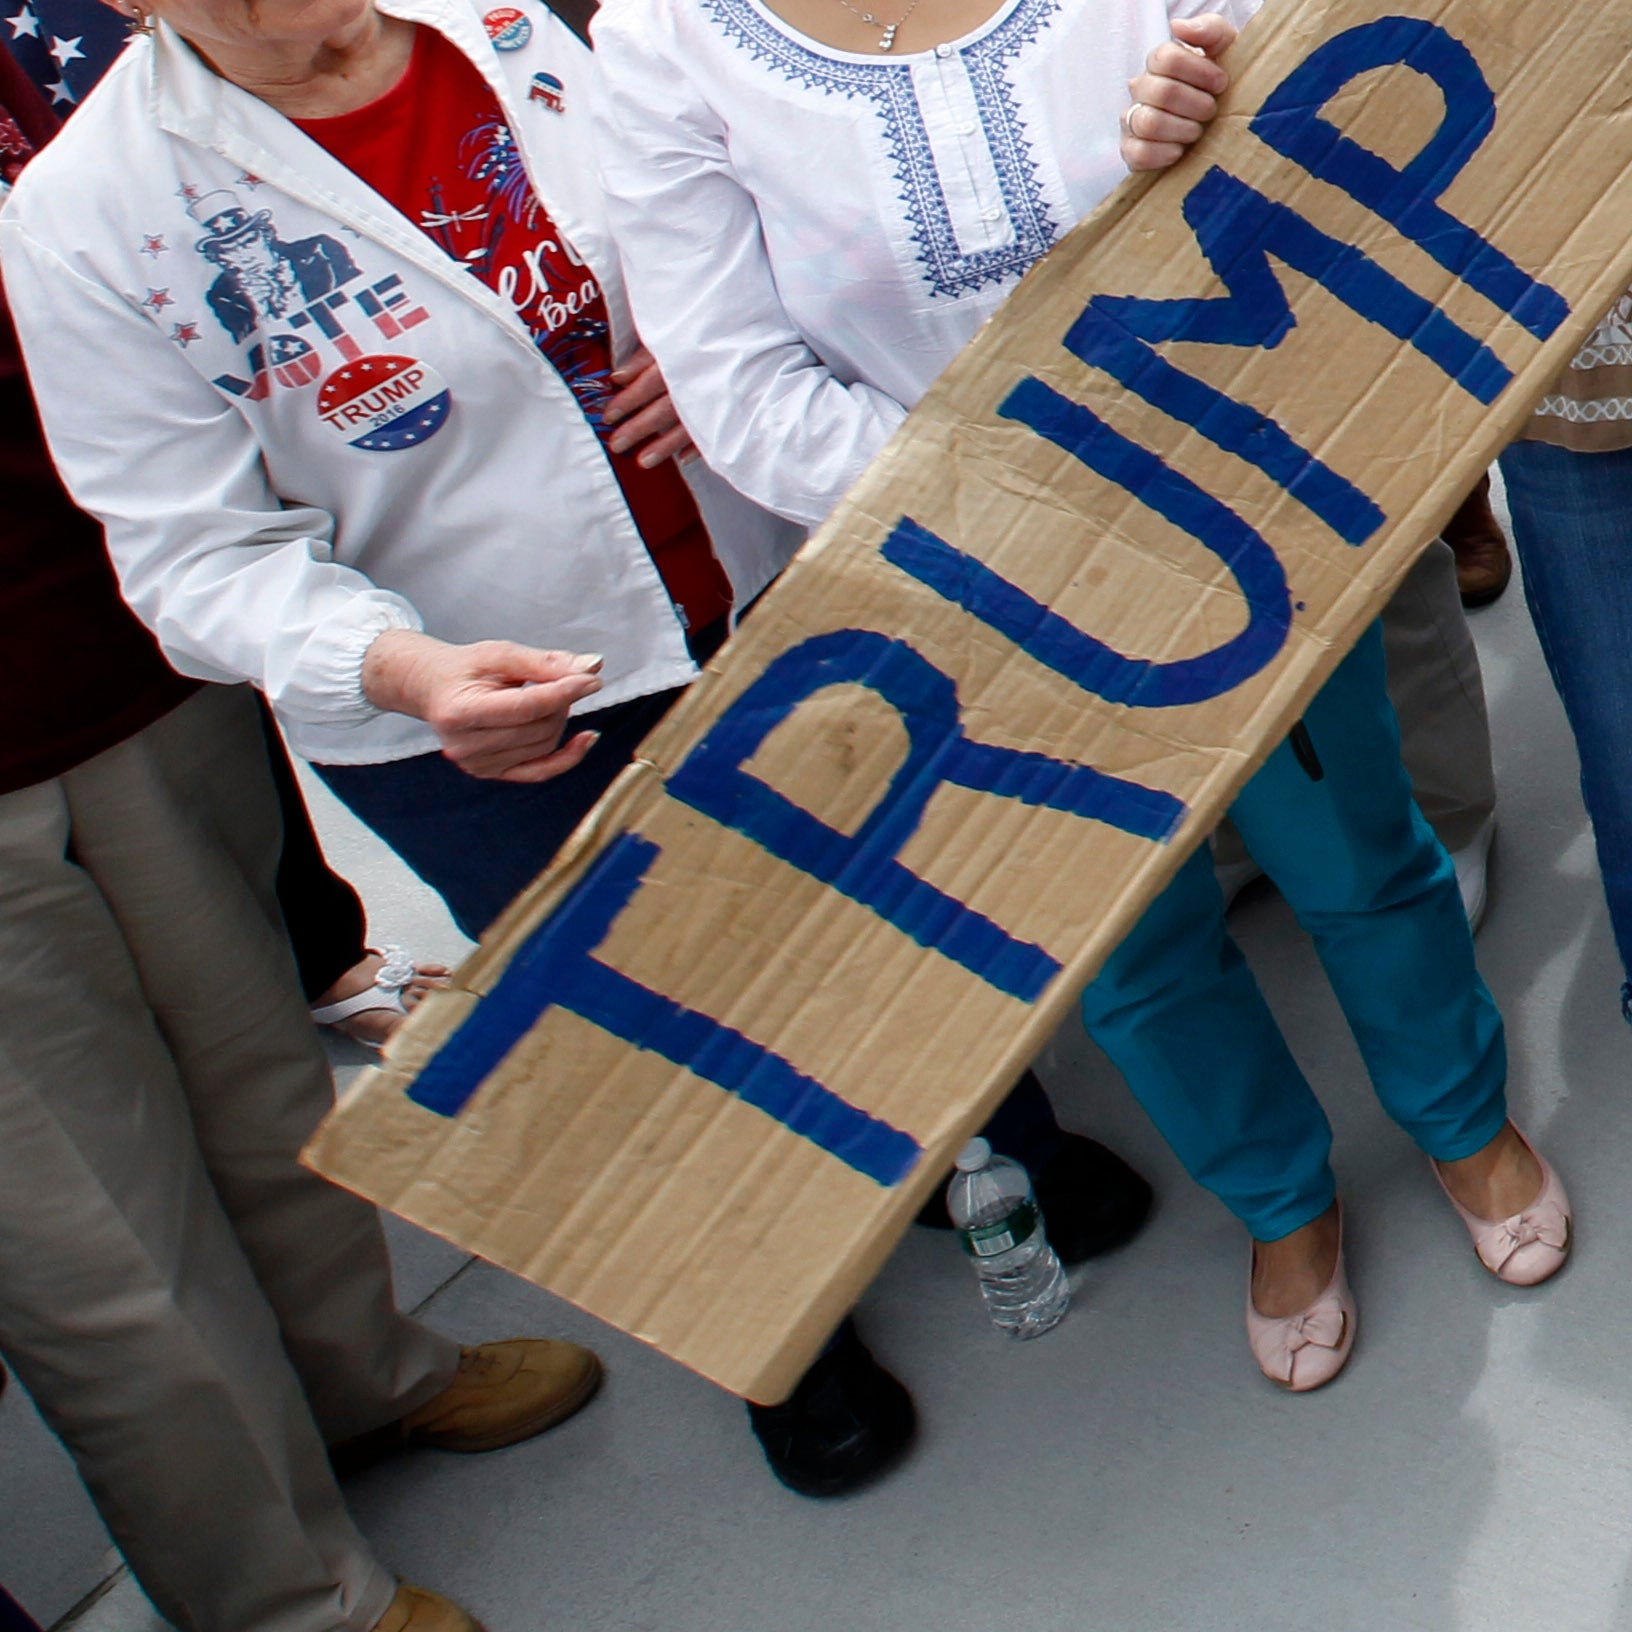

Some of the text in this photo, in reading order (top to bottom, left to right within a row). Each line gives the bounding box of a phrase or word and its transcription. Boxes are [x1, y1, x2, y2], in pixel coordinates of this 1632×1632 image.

[211, 273, 431, 403] VOTE
[322, 369, 424, 432] TRUMP
[368, 404, 406, 428] 2016
[406, 14, 1572, 1188] TRUMP
